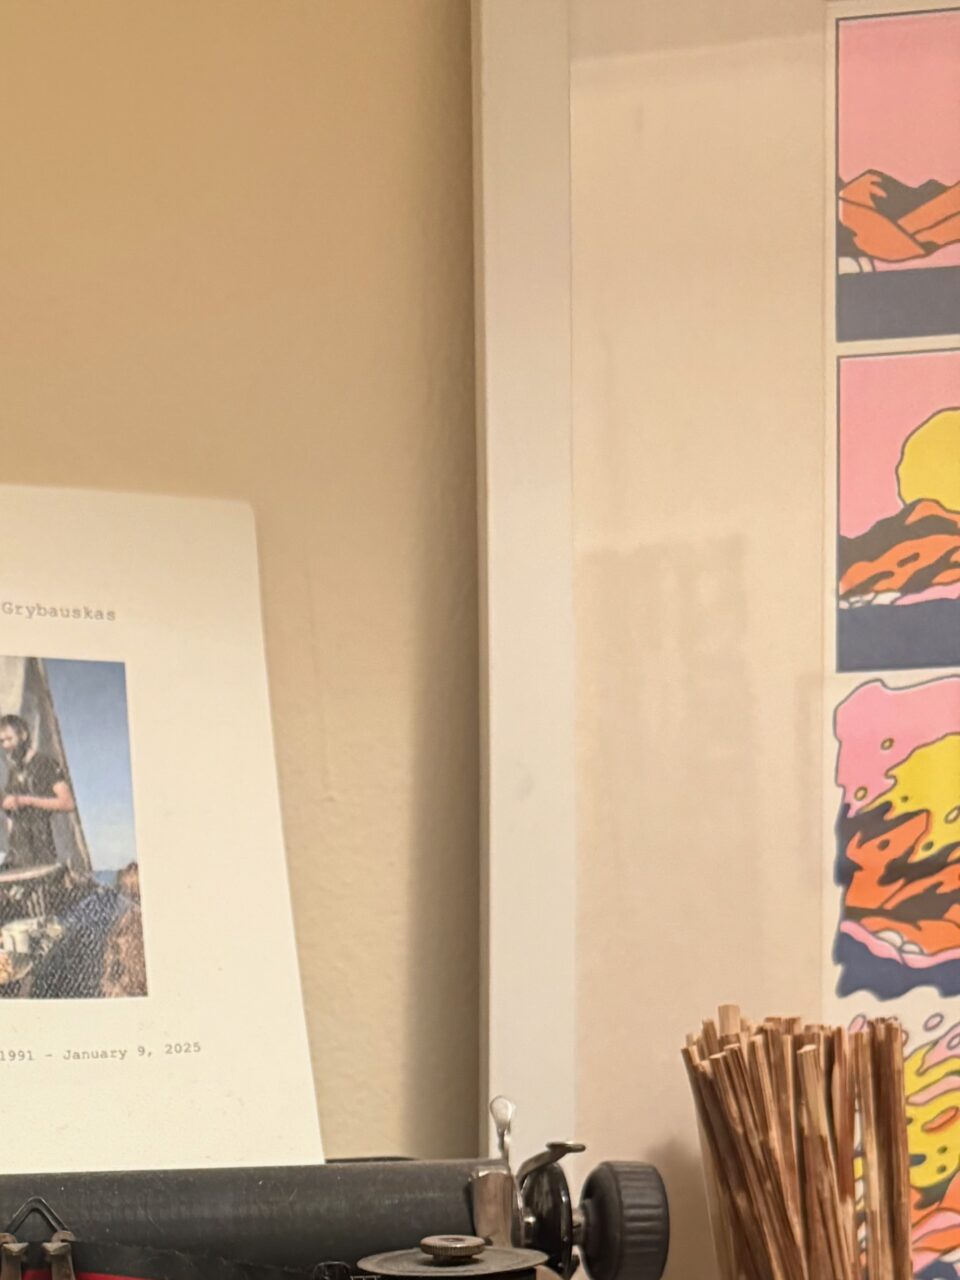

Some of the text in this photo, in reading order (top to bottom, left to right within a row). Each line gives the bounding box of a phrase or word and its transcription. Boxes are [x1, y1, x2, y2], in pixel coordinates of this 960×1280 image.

[1, 601, 116, 621] Grybauskas
[63, 1049, 128, 1061] January
[137, 1045, 152, 1057] 9,
[164, 1042, 202, 1055] 2025
